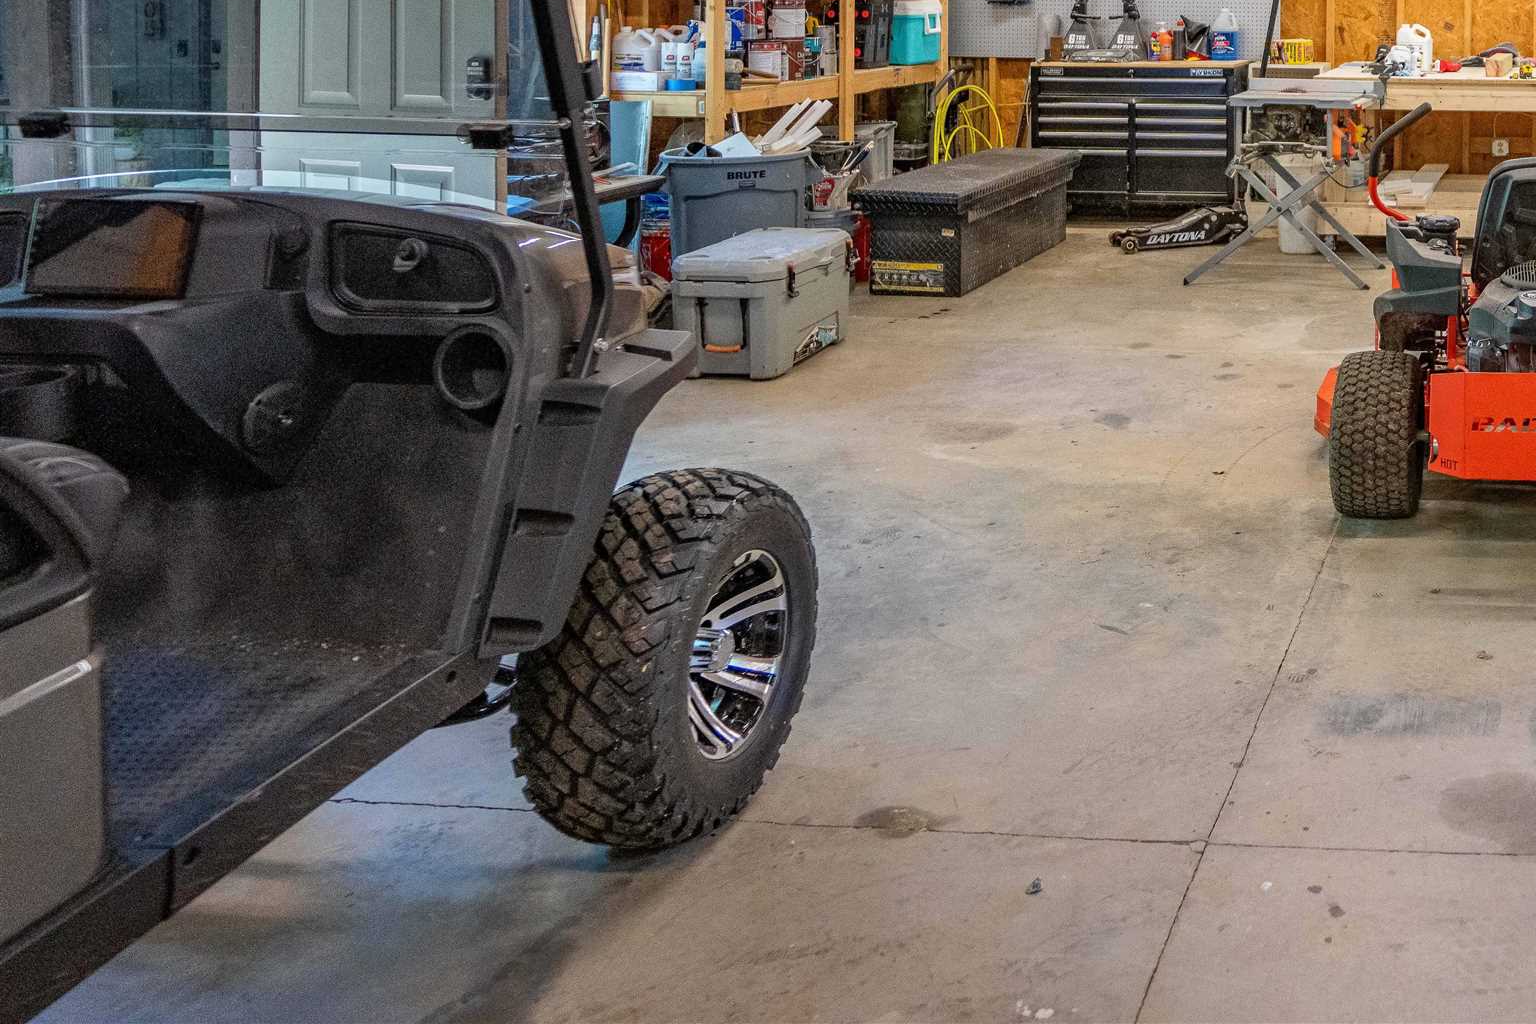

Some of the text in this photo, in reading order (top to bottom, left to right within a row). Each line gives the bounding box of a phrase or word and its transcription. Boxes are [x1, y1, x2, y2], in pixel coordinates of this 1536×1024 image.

[727, 170, 767, 180] BRUTE
[1146, 230, 1207, 245] DAYTONA
[1440, 457, 1459, 471] HOT
